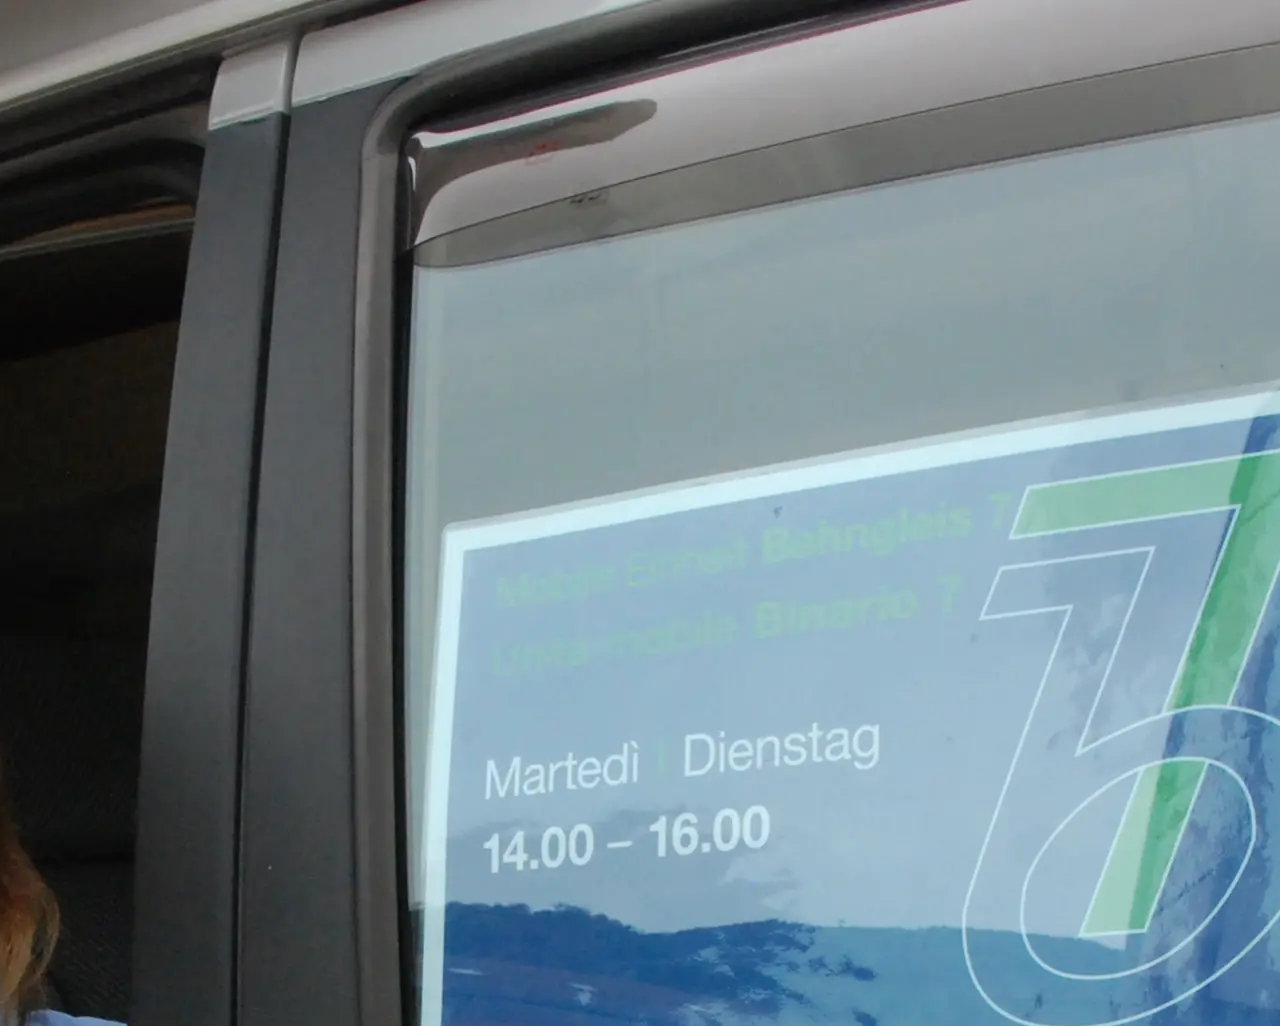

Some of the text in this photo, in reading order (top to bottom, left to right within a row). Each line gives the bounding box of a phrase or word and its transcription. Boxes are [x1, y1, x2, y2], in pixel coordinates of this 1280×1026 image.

[762, 501, 972, 563] Bahngleis
[754, 585, 917, 640] Binario
[485, 740, 640, 800] Martedì
[683, 722, 881, 777] Dienstag
[483, 823, 595, 873] 14.00
[650, 805, 771, 858] 16.00
